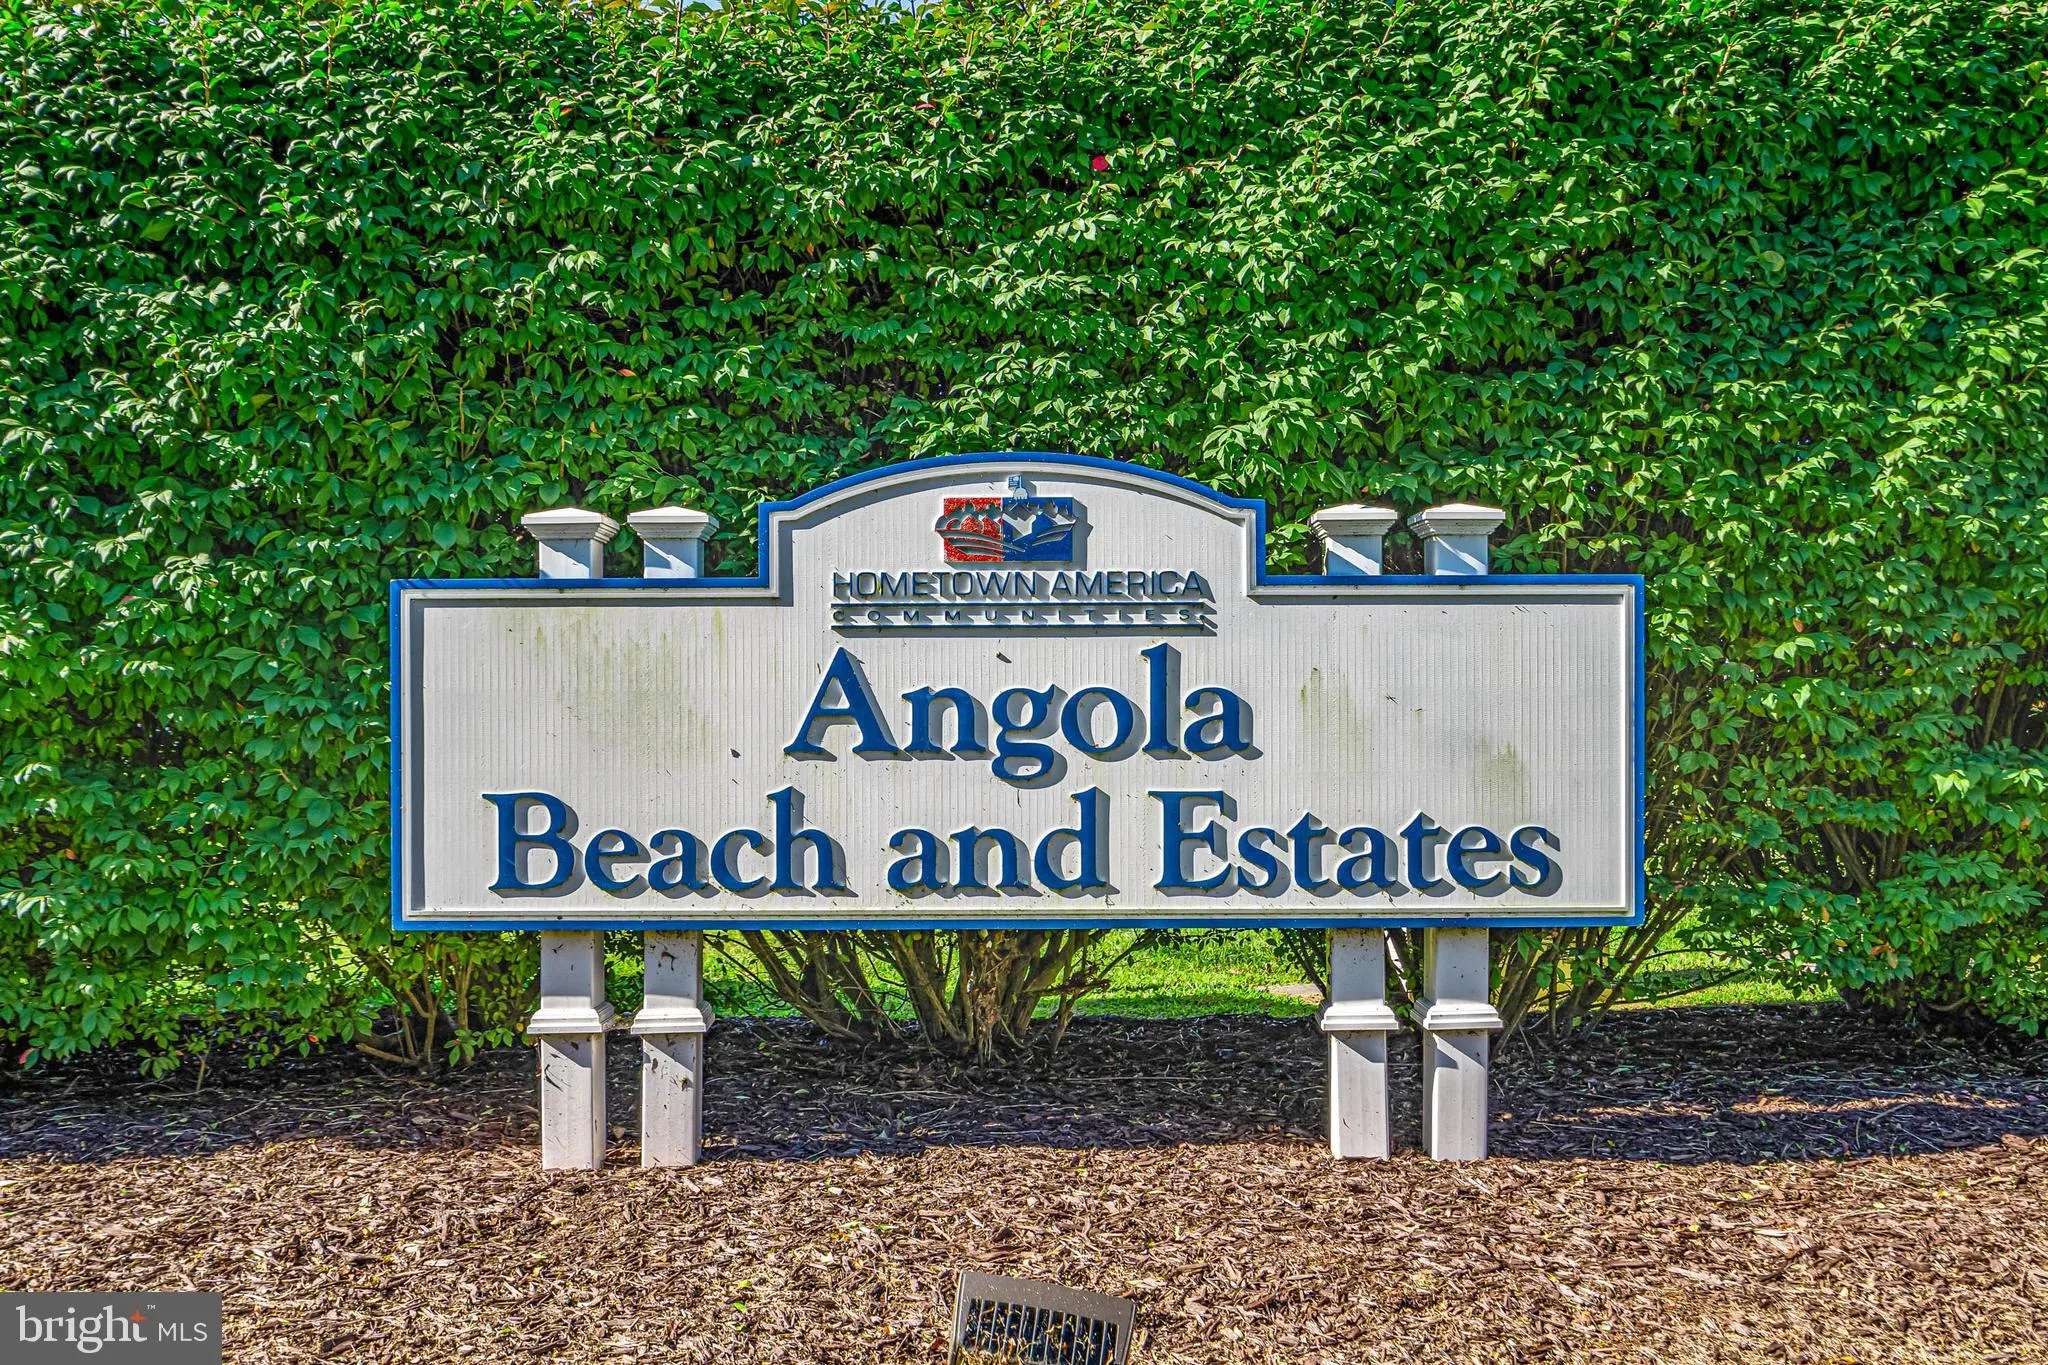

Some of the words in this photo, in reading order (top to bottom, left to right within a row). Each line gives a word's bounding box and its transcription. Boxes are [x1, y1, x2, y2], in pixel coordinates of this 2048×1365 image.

[832, 570, 1037, 598] HOMETOWN
[1051, 570, 1203, 597] AMERICA
[783, 642, 1251, 781] Angola
[481, 786, 846, 891] Beach
[887, 786, 1107, 891] and
[1147, 790, 1550, 890] Estates
